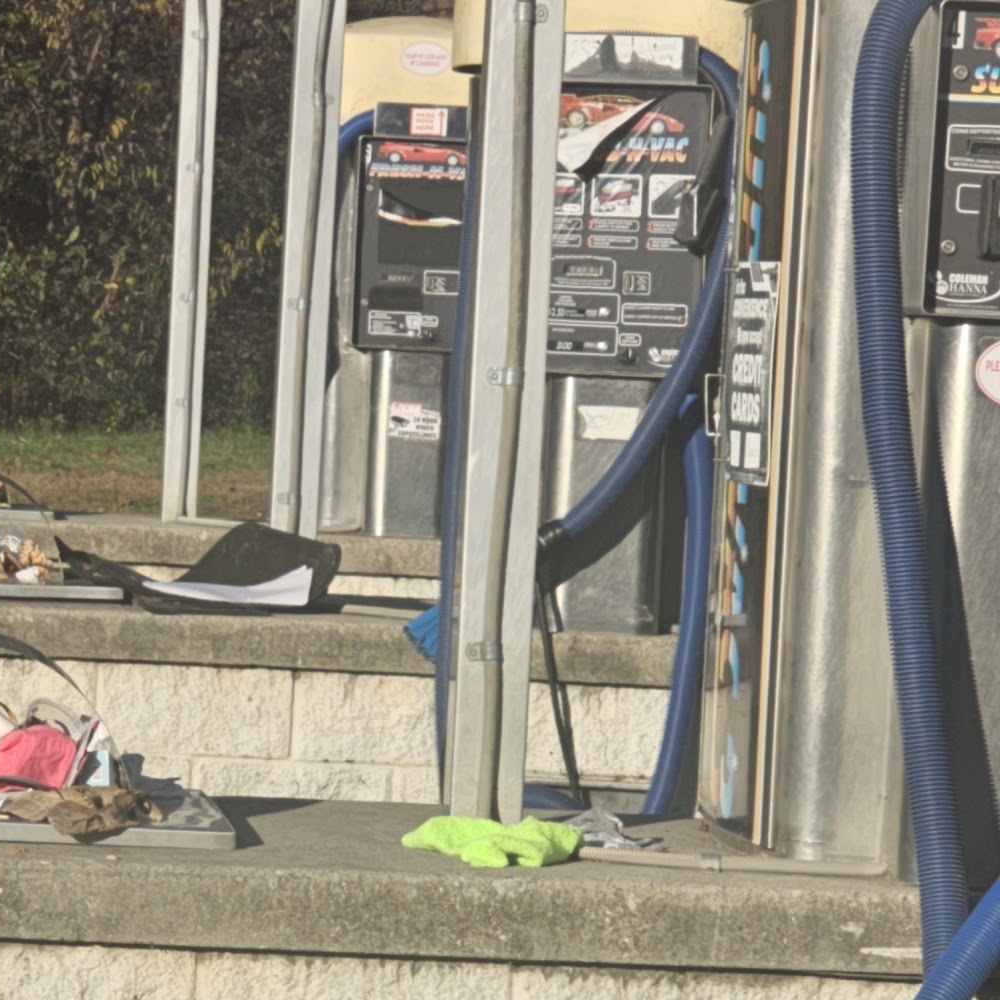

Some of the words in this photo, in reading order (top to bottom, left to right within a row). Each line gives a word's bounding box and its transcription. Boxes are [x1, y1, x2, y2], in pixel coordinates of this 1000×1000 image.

[949, 273, 988, 284] COLEMAN
[950, 283, 988, 294] HANNA
[731, 353, 763, 387] CREDIT
[731, 391, 761, 429] CARDS
